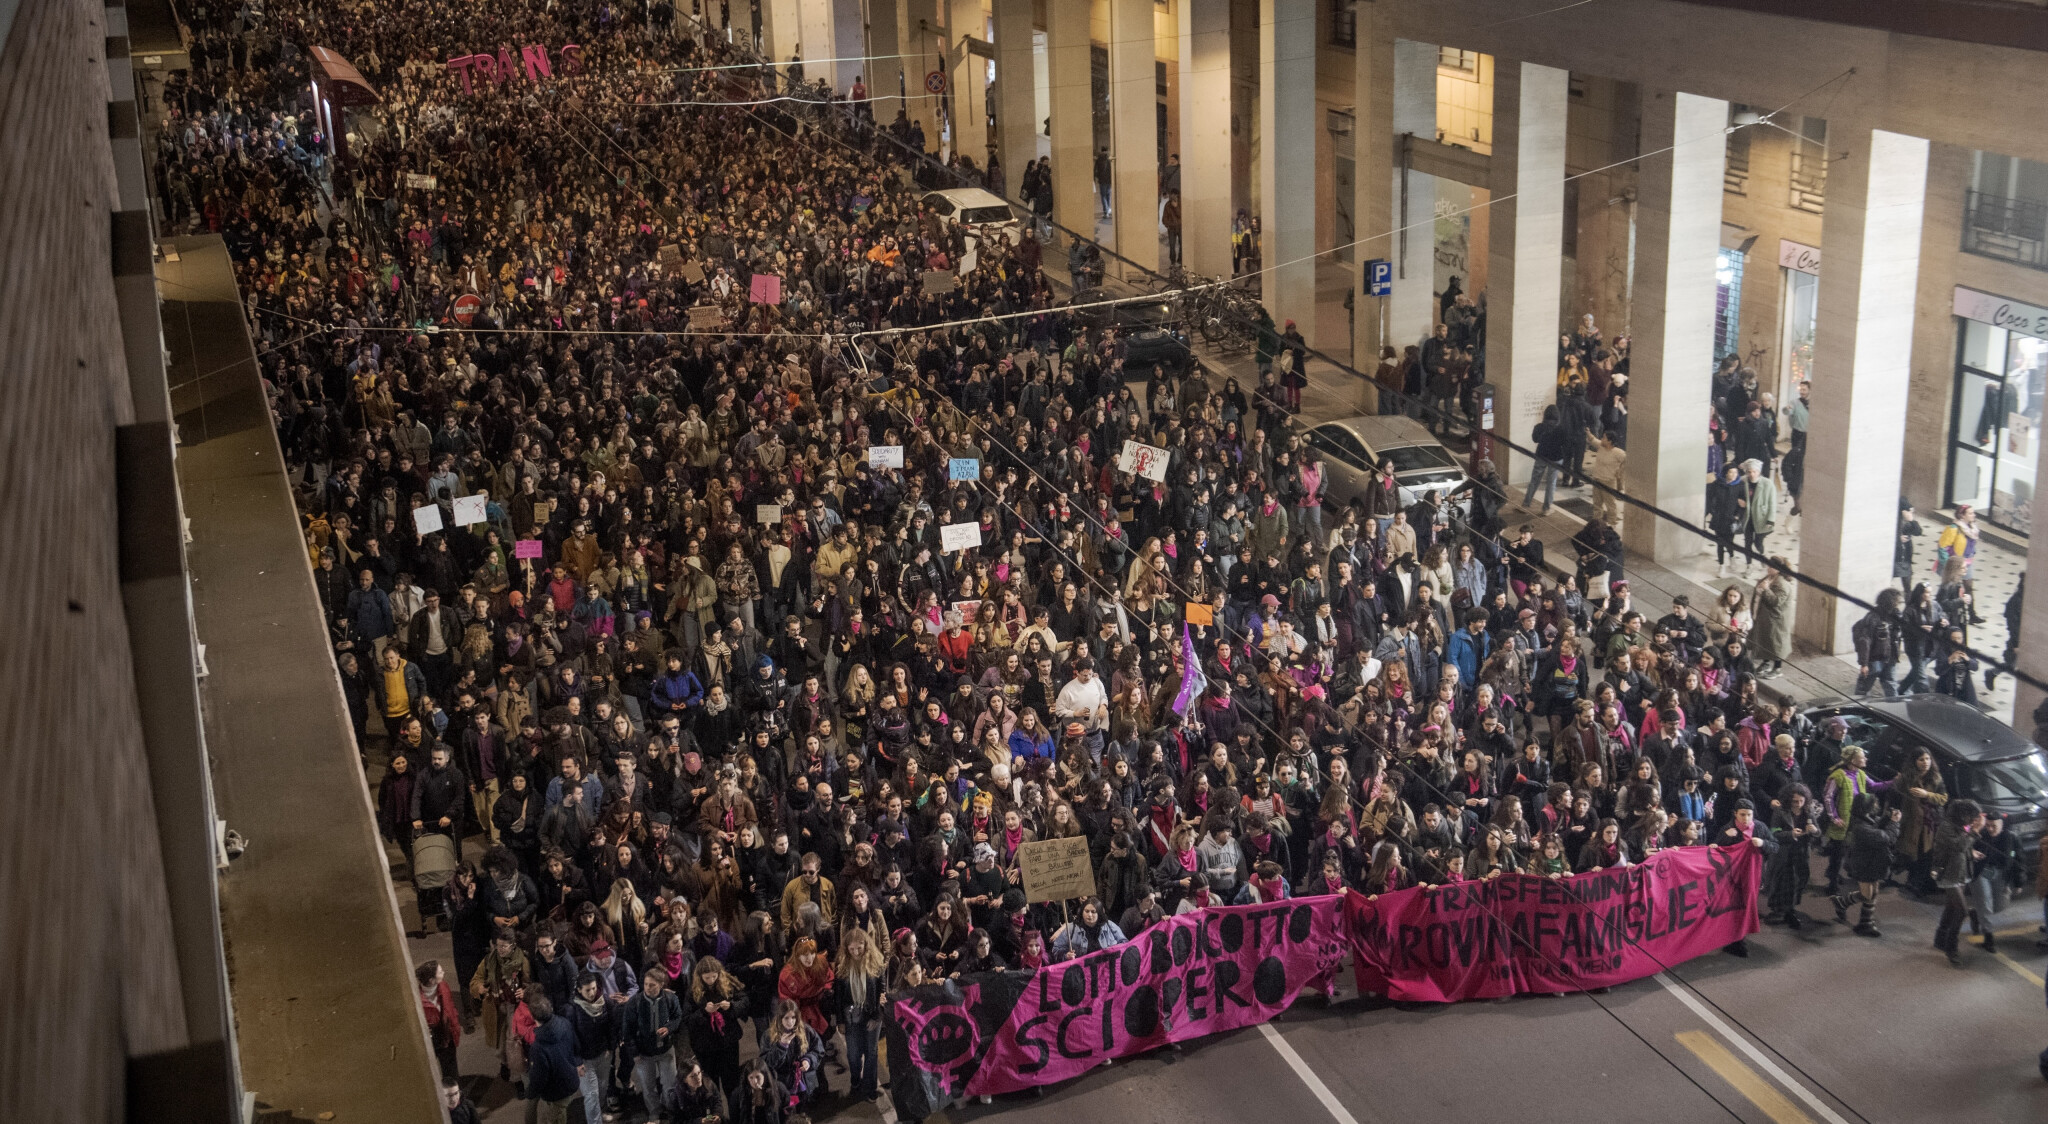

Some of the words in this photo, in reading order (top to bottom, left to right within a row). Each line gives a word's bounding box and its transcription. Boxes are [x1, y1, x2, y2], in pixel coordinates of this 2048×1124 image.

[448, 44, 581, 95] TRANS
[1376, 265, 1388, 282] P
[848, 321, 865, 329] YALE
[1993, 304, 2029, 329] Coco
[871, 447, 899, 456] SOLIDARITY
[1129, 465, 1152, 477] PALA
[1039, 946, 1141, 1012] LOTTO
[1150, 905, 1312, 975] BOICOTTO
[1577, 954, 1622, 976] MENO
[1015, 956, 1286, 1074] SCIOPERO
